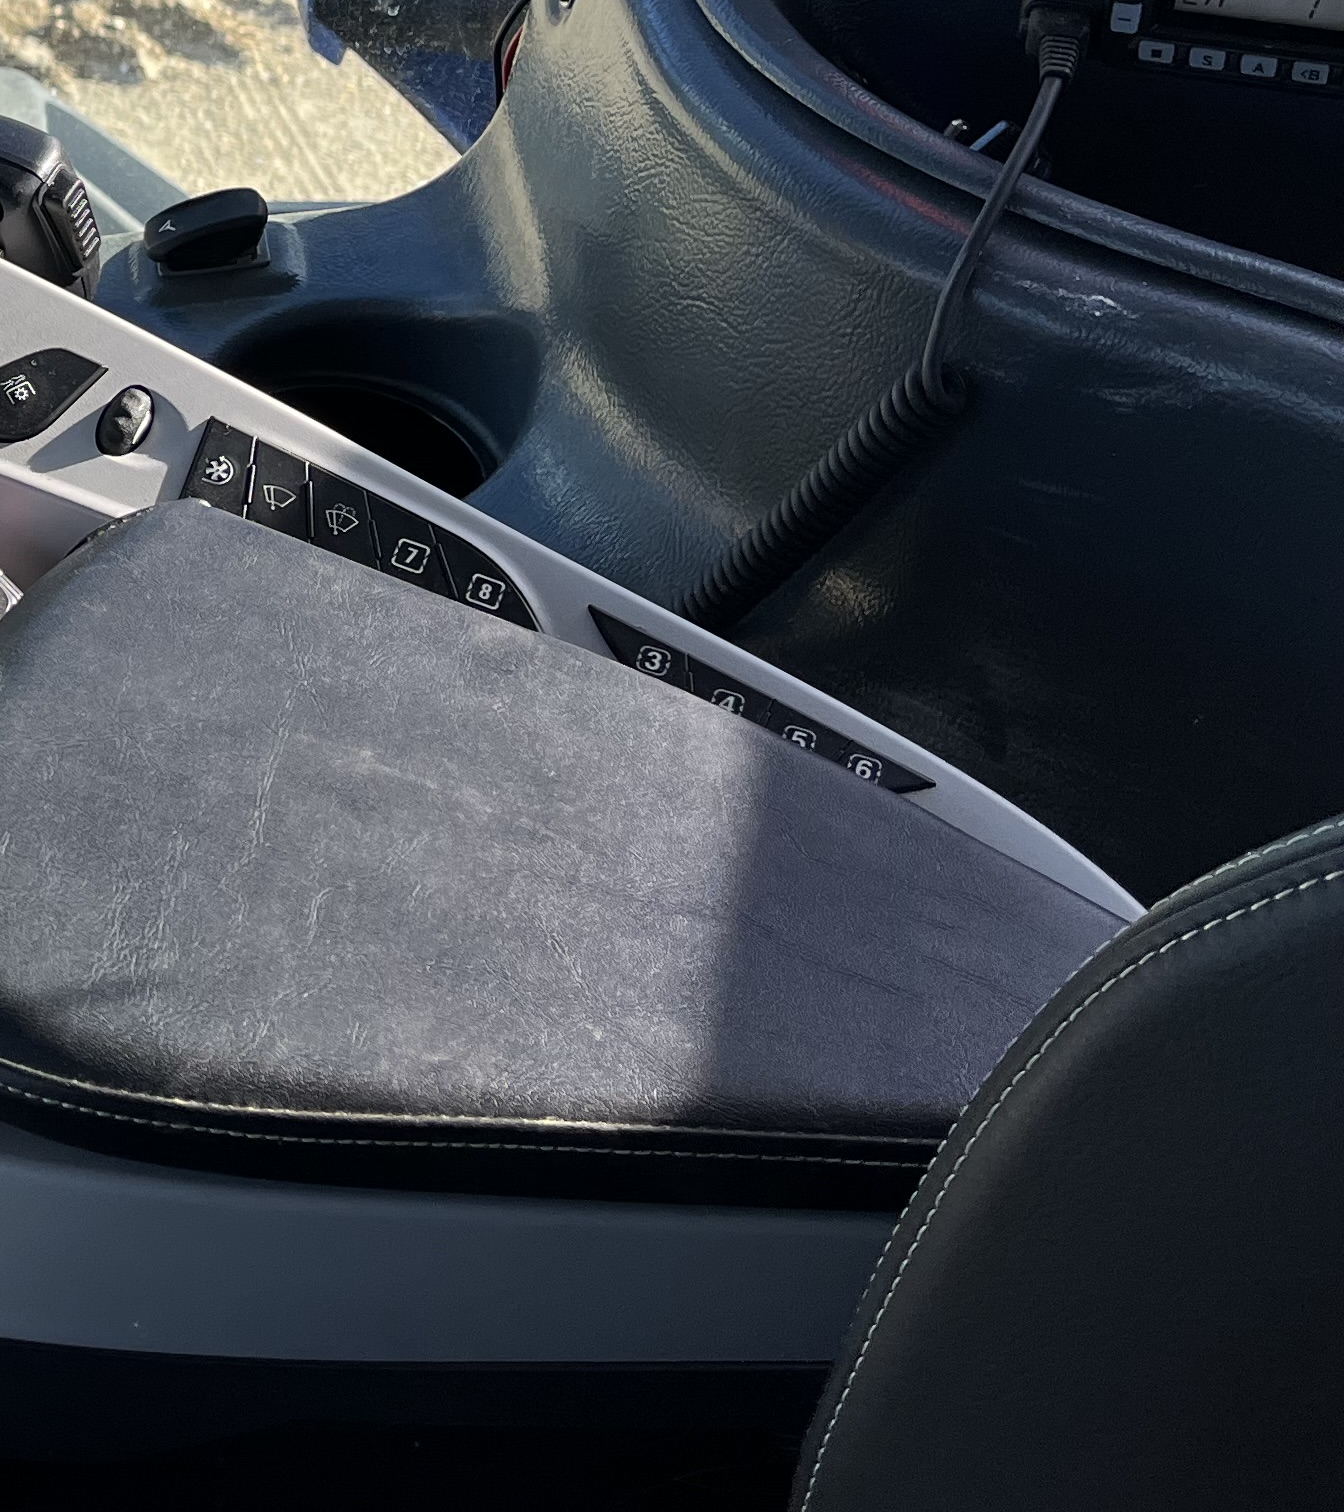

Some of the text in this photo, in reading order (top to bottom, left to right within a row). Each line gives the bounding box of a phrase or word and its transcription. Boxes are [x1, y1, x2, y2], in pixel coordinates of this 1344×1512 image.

[405, 547, 419, 564] 7
[478, 583, 493, 600] 8
[644, 651, 663, 671] 3
[718, 695, 735, 713] 4
[792, 731, 808, 748] 5
[855, 760, 873, 780] 6
